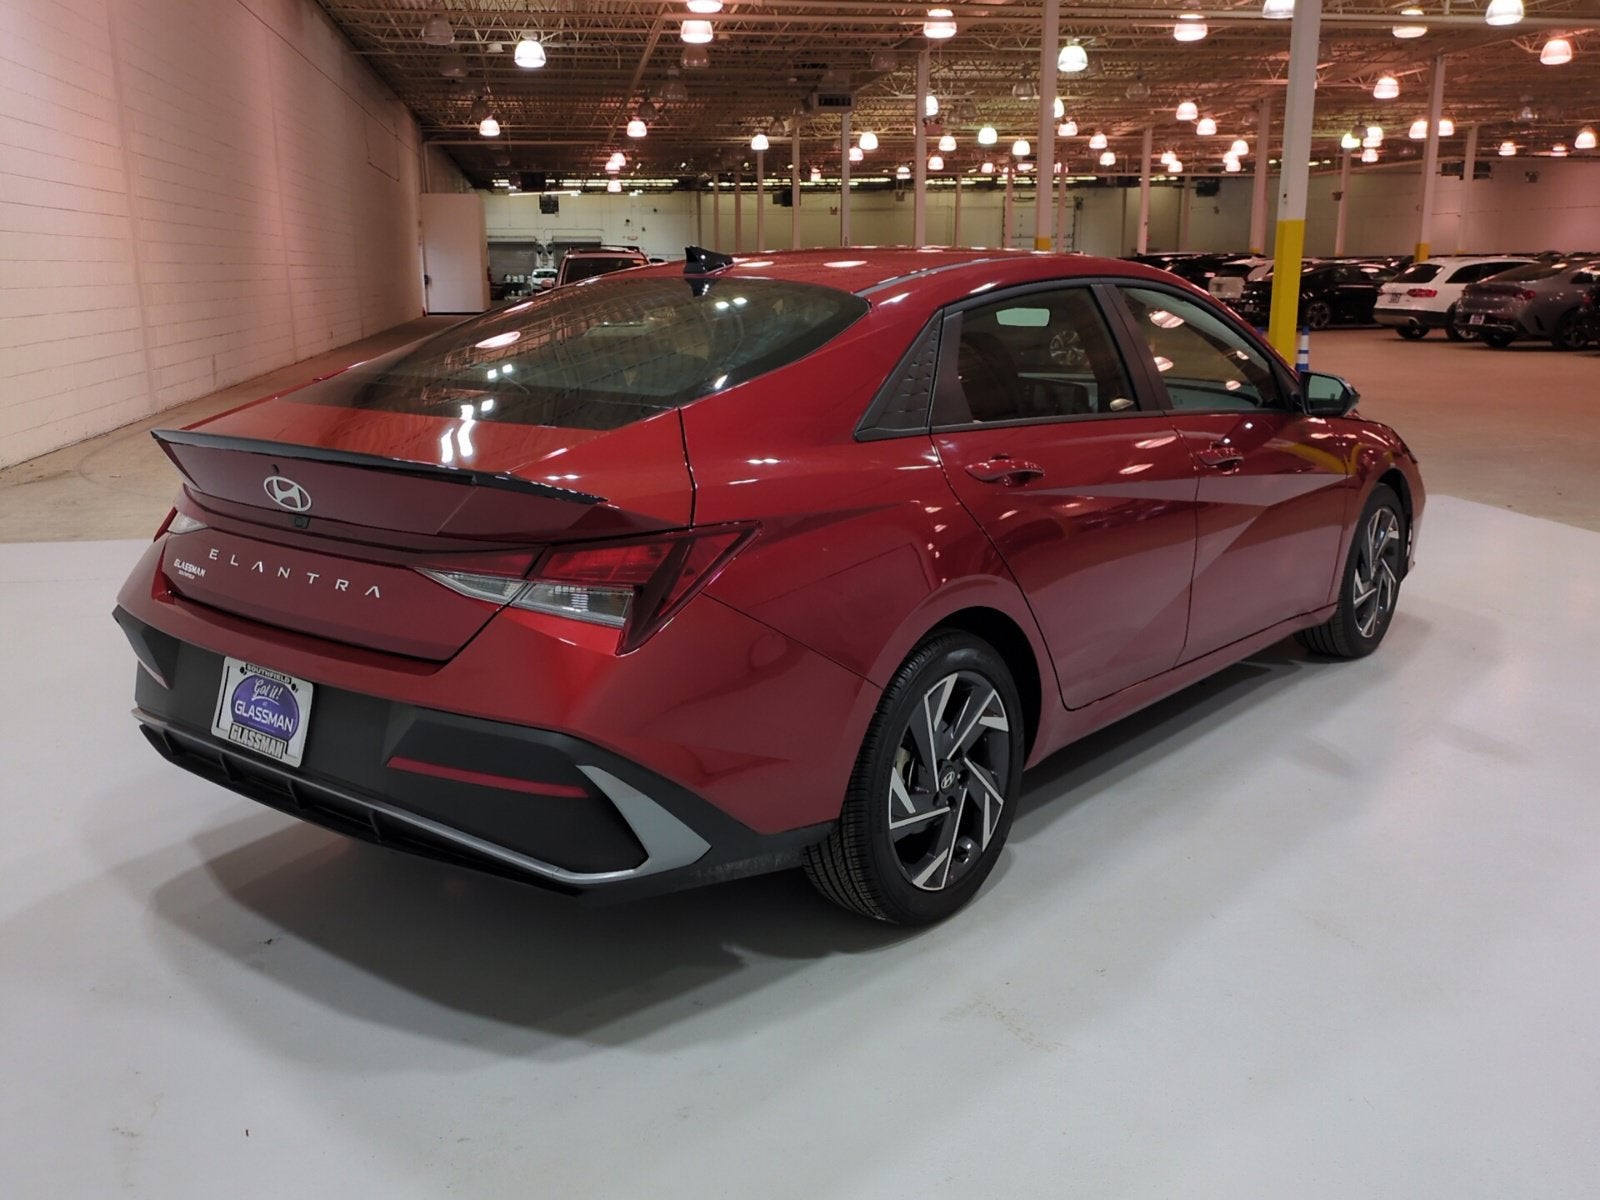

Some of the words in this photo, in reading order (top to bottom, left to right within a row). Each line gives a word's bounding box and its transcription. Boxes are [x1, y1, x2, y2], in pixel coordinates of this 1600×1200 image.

[174, 558, 206, 577] GLASSMAN
[209, 548, 380, 598] ELANTRA
[247, 664, 290, 684] SOUTHFIELD
[253, 679, 270, 698] Got
[269, 685, 284, 700] it!
[234, 700, 294, 732] GLASSMAN
[229, 724, 285, 759] GLASSMAN
